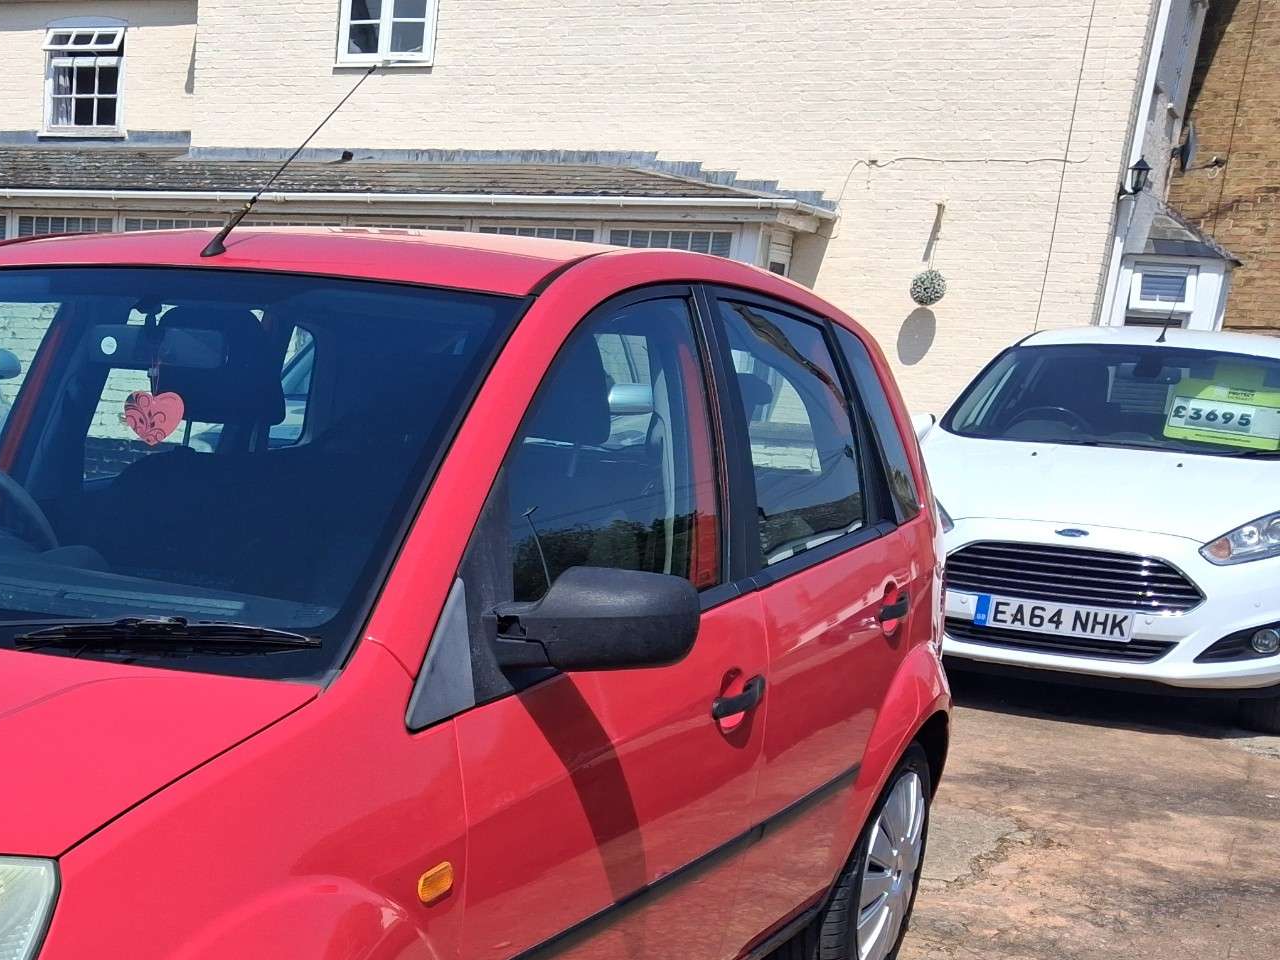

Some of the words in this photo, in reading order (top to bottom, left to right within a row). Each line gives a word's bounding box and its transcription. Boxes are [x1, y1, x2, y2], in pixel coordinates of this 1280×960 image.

[1172, 405, 1252, 427] £3695
[992, 602, 1063, 630] EA64
[1072, 610, 1129, 637] NHK
